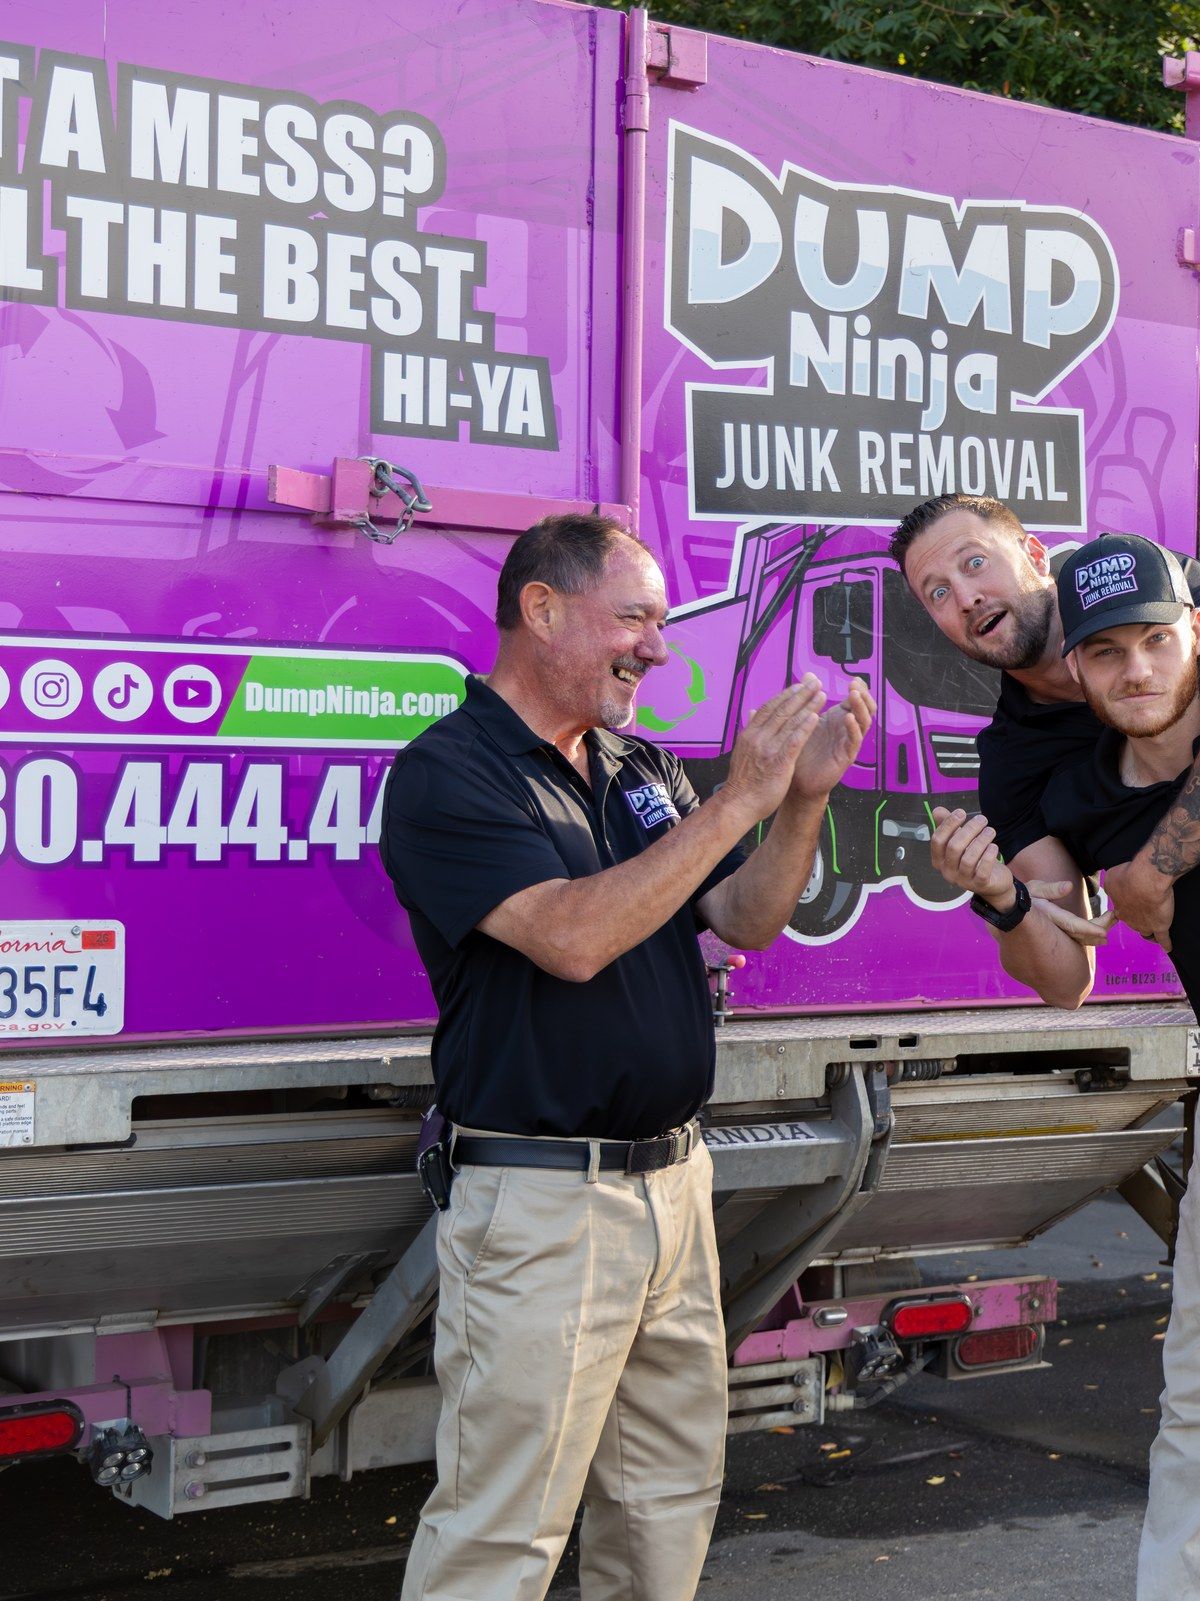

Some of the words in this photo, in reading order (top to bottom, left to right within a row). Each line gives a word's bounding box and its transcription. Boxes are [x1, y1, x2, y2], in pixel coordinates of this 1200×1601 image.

[40, 66, 106, 173] A
[131, 80, 434, 218] MESS?
[66, 196, 238, 315] THE
[263, 224, 483, 344] BEST.
[688, 156, 1101, 349] DUMP
[383, 353, 546, 437] HI-YA
[789, 311, 998, 431] Ninja
[716, 423, 841, 494] JUNK
[860, 433, 1068, 502] REMOVAL
[1078, 556, 1132, 587] DUMP
[1085, 589, 1101, 605] JUNK
[1101, 580, 1133, 596] REMOVAL
[1090, 572, 1120, 589] Ninja
[246, 682, 458, 718] DumpNinja.com
[0, 759, 383, 864] 0.444.4
[0, 1084, 23, 1093] RNING
